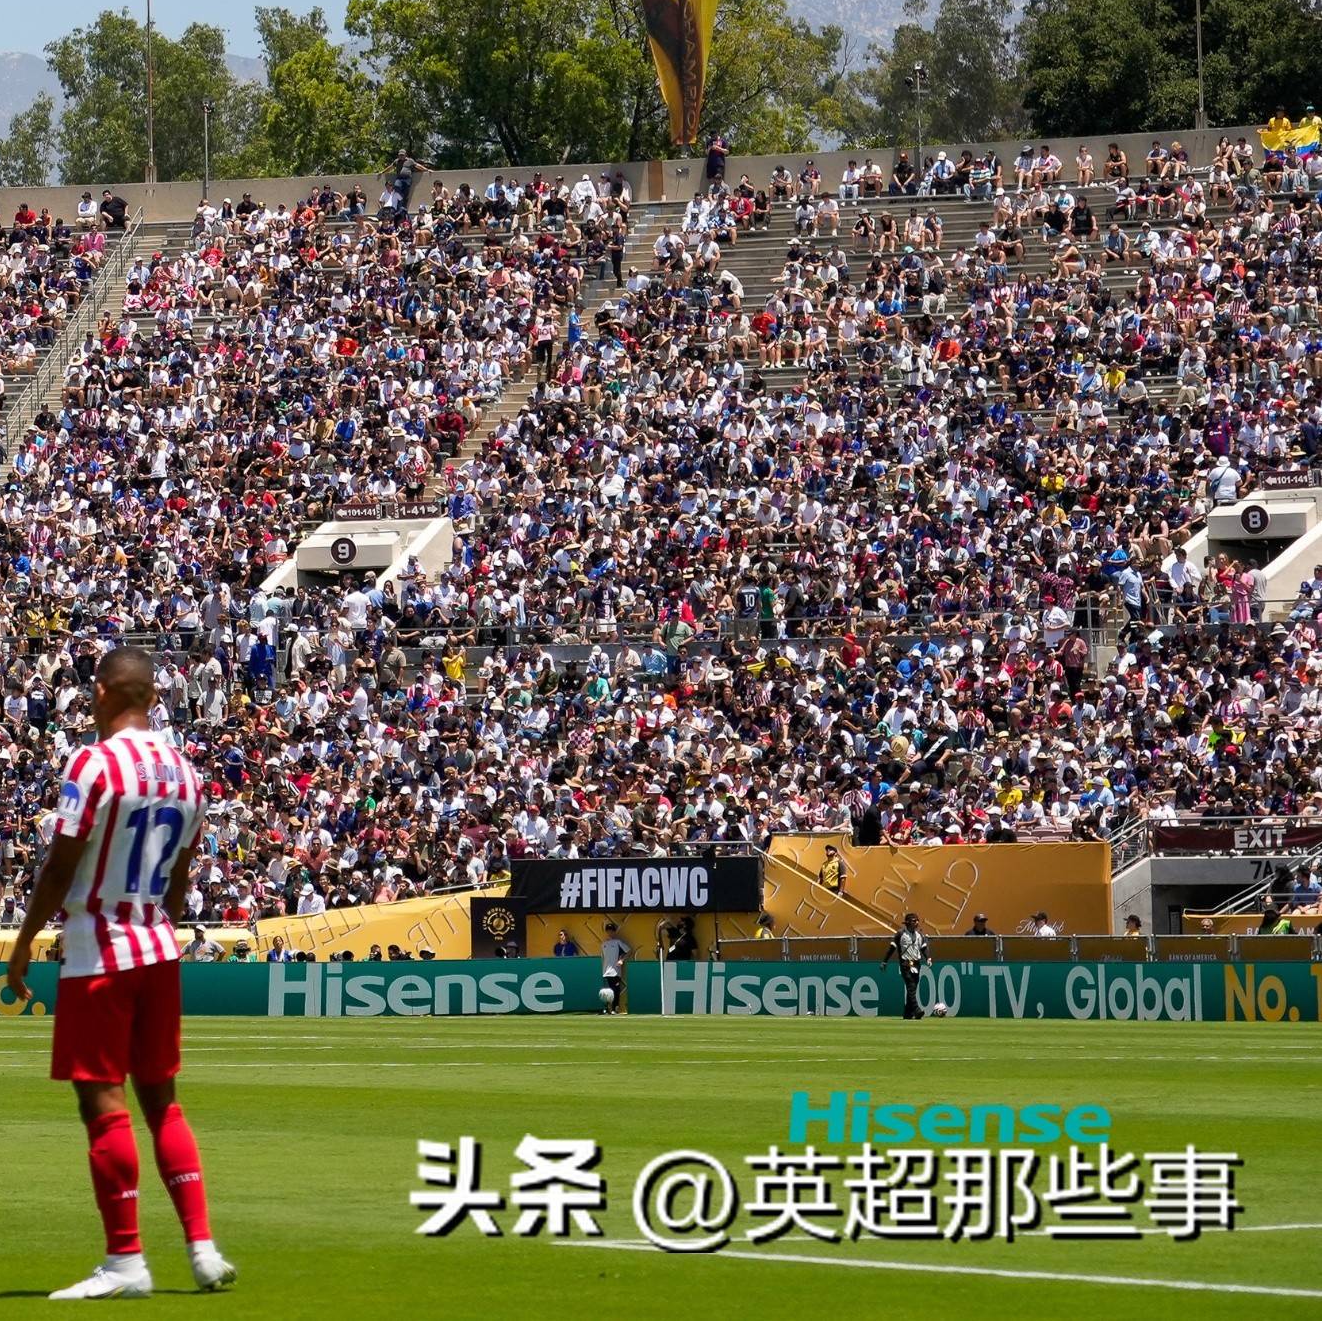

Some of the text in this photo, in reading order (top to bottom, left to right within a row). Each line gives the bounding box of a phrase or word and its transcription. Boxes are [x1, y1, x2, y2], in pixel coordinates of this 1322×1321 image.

[1277, 475, 1308, 484] 101-141
[347, 508, 376, 517] 101-141
[400, 506, 426, 516] 1-41
[1249, 511, 1261, 529] 8
[338, 543, 349, 559] 9
[745, 594, 755, 607] 10
[1234, 828, 1287, 849] EXIT
[126, 806, 184, 895] 12
[1250, 860, 1274, 879] 7A
[560, 866, 709, 909] #FIFACWC
[268, 962, 564, 1016] Hisense
[663, 962, 879, 1017] Hisense
[899, 961, 973, 1017] 00"
[980, 965, 1044, 1019] TV,
[1065, 963, 1202, 1022] Global
[1224, 964, 1300, 1022] No.
